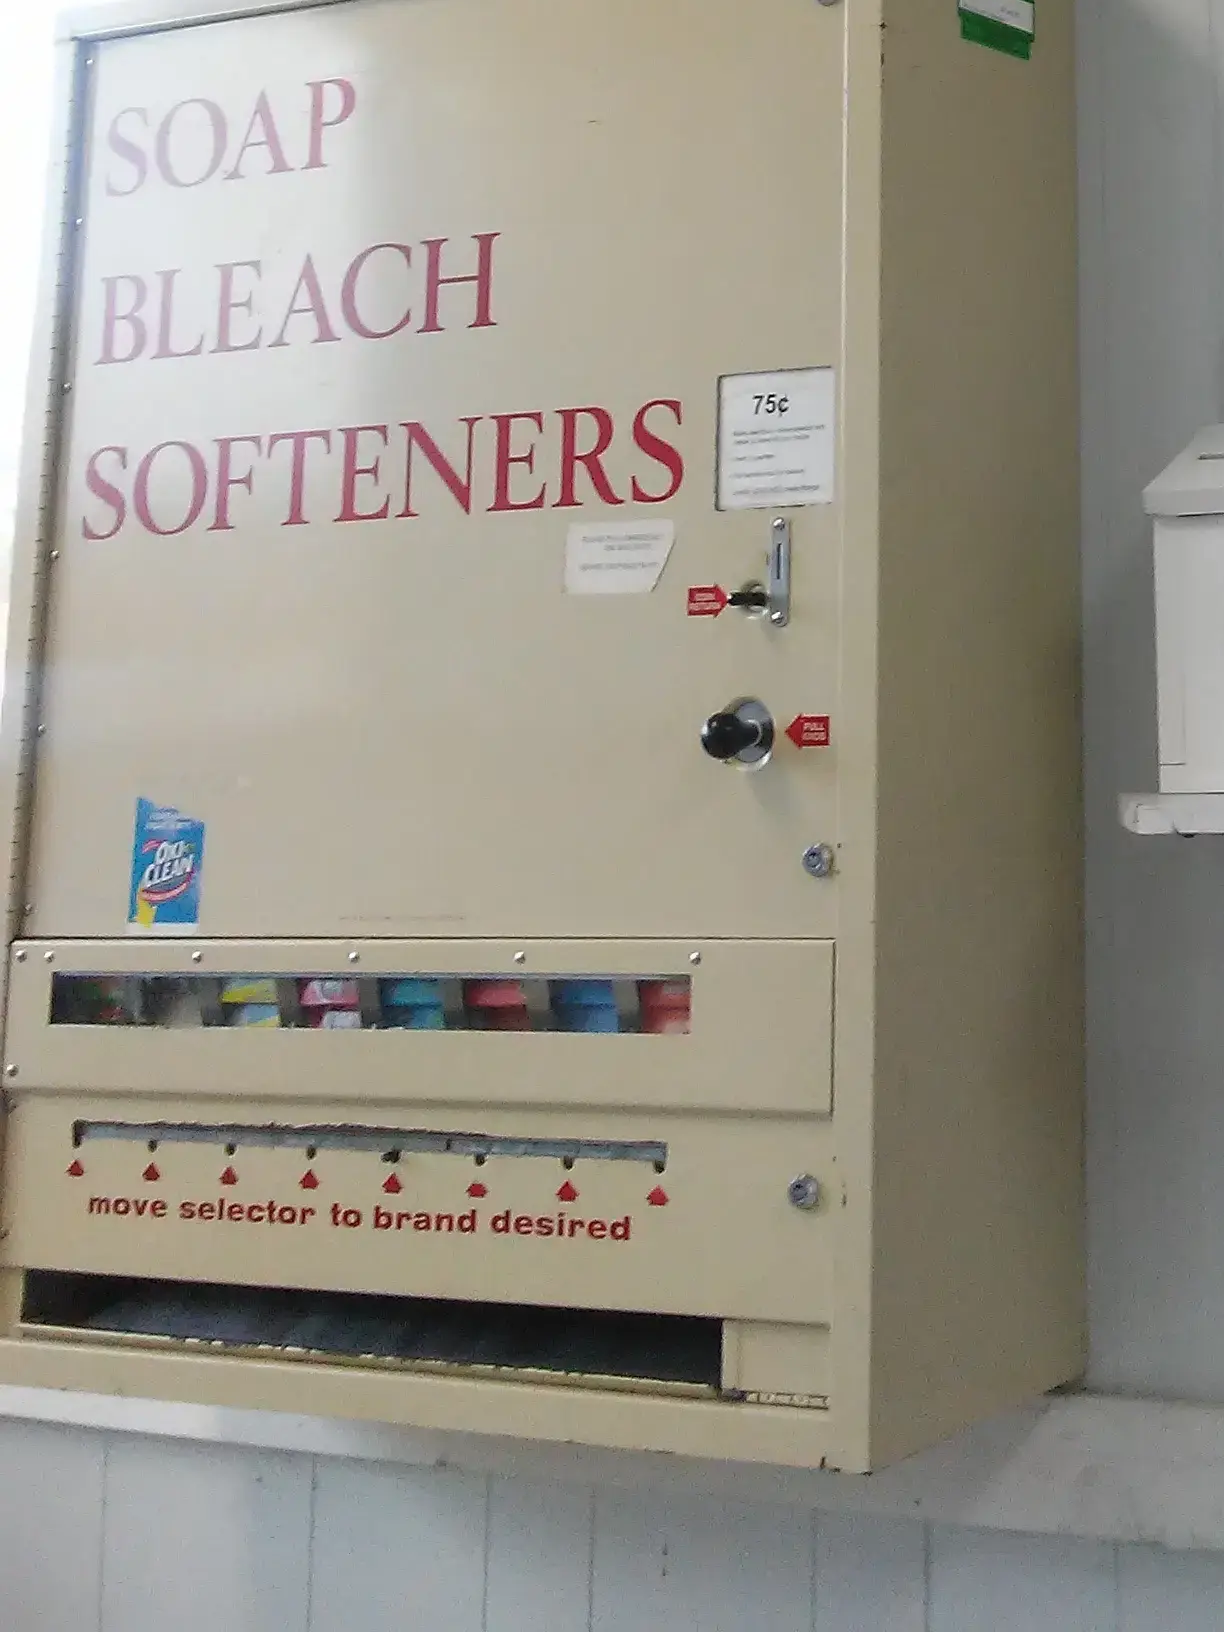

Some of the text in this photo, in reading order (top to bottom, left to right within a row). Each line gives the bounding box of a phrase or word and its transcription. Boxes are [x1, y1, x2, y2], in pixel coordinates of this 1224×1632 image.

[105, 76, 357, 197] SOAP
[93, 232, 502, 366] BLEACH
[752, 393, 790, 417] 75¢
[81, 398, 684, 541] SOFTENERS
[89, 1193, 632, 1242] move selector to brand desired
